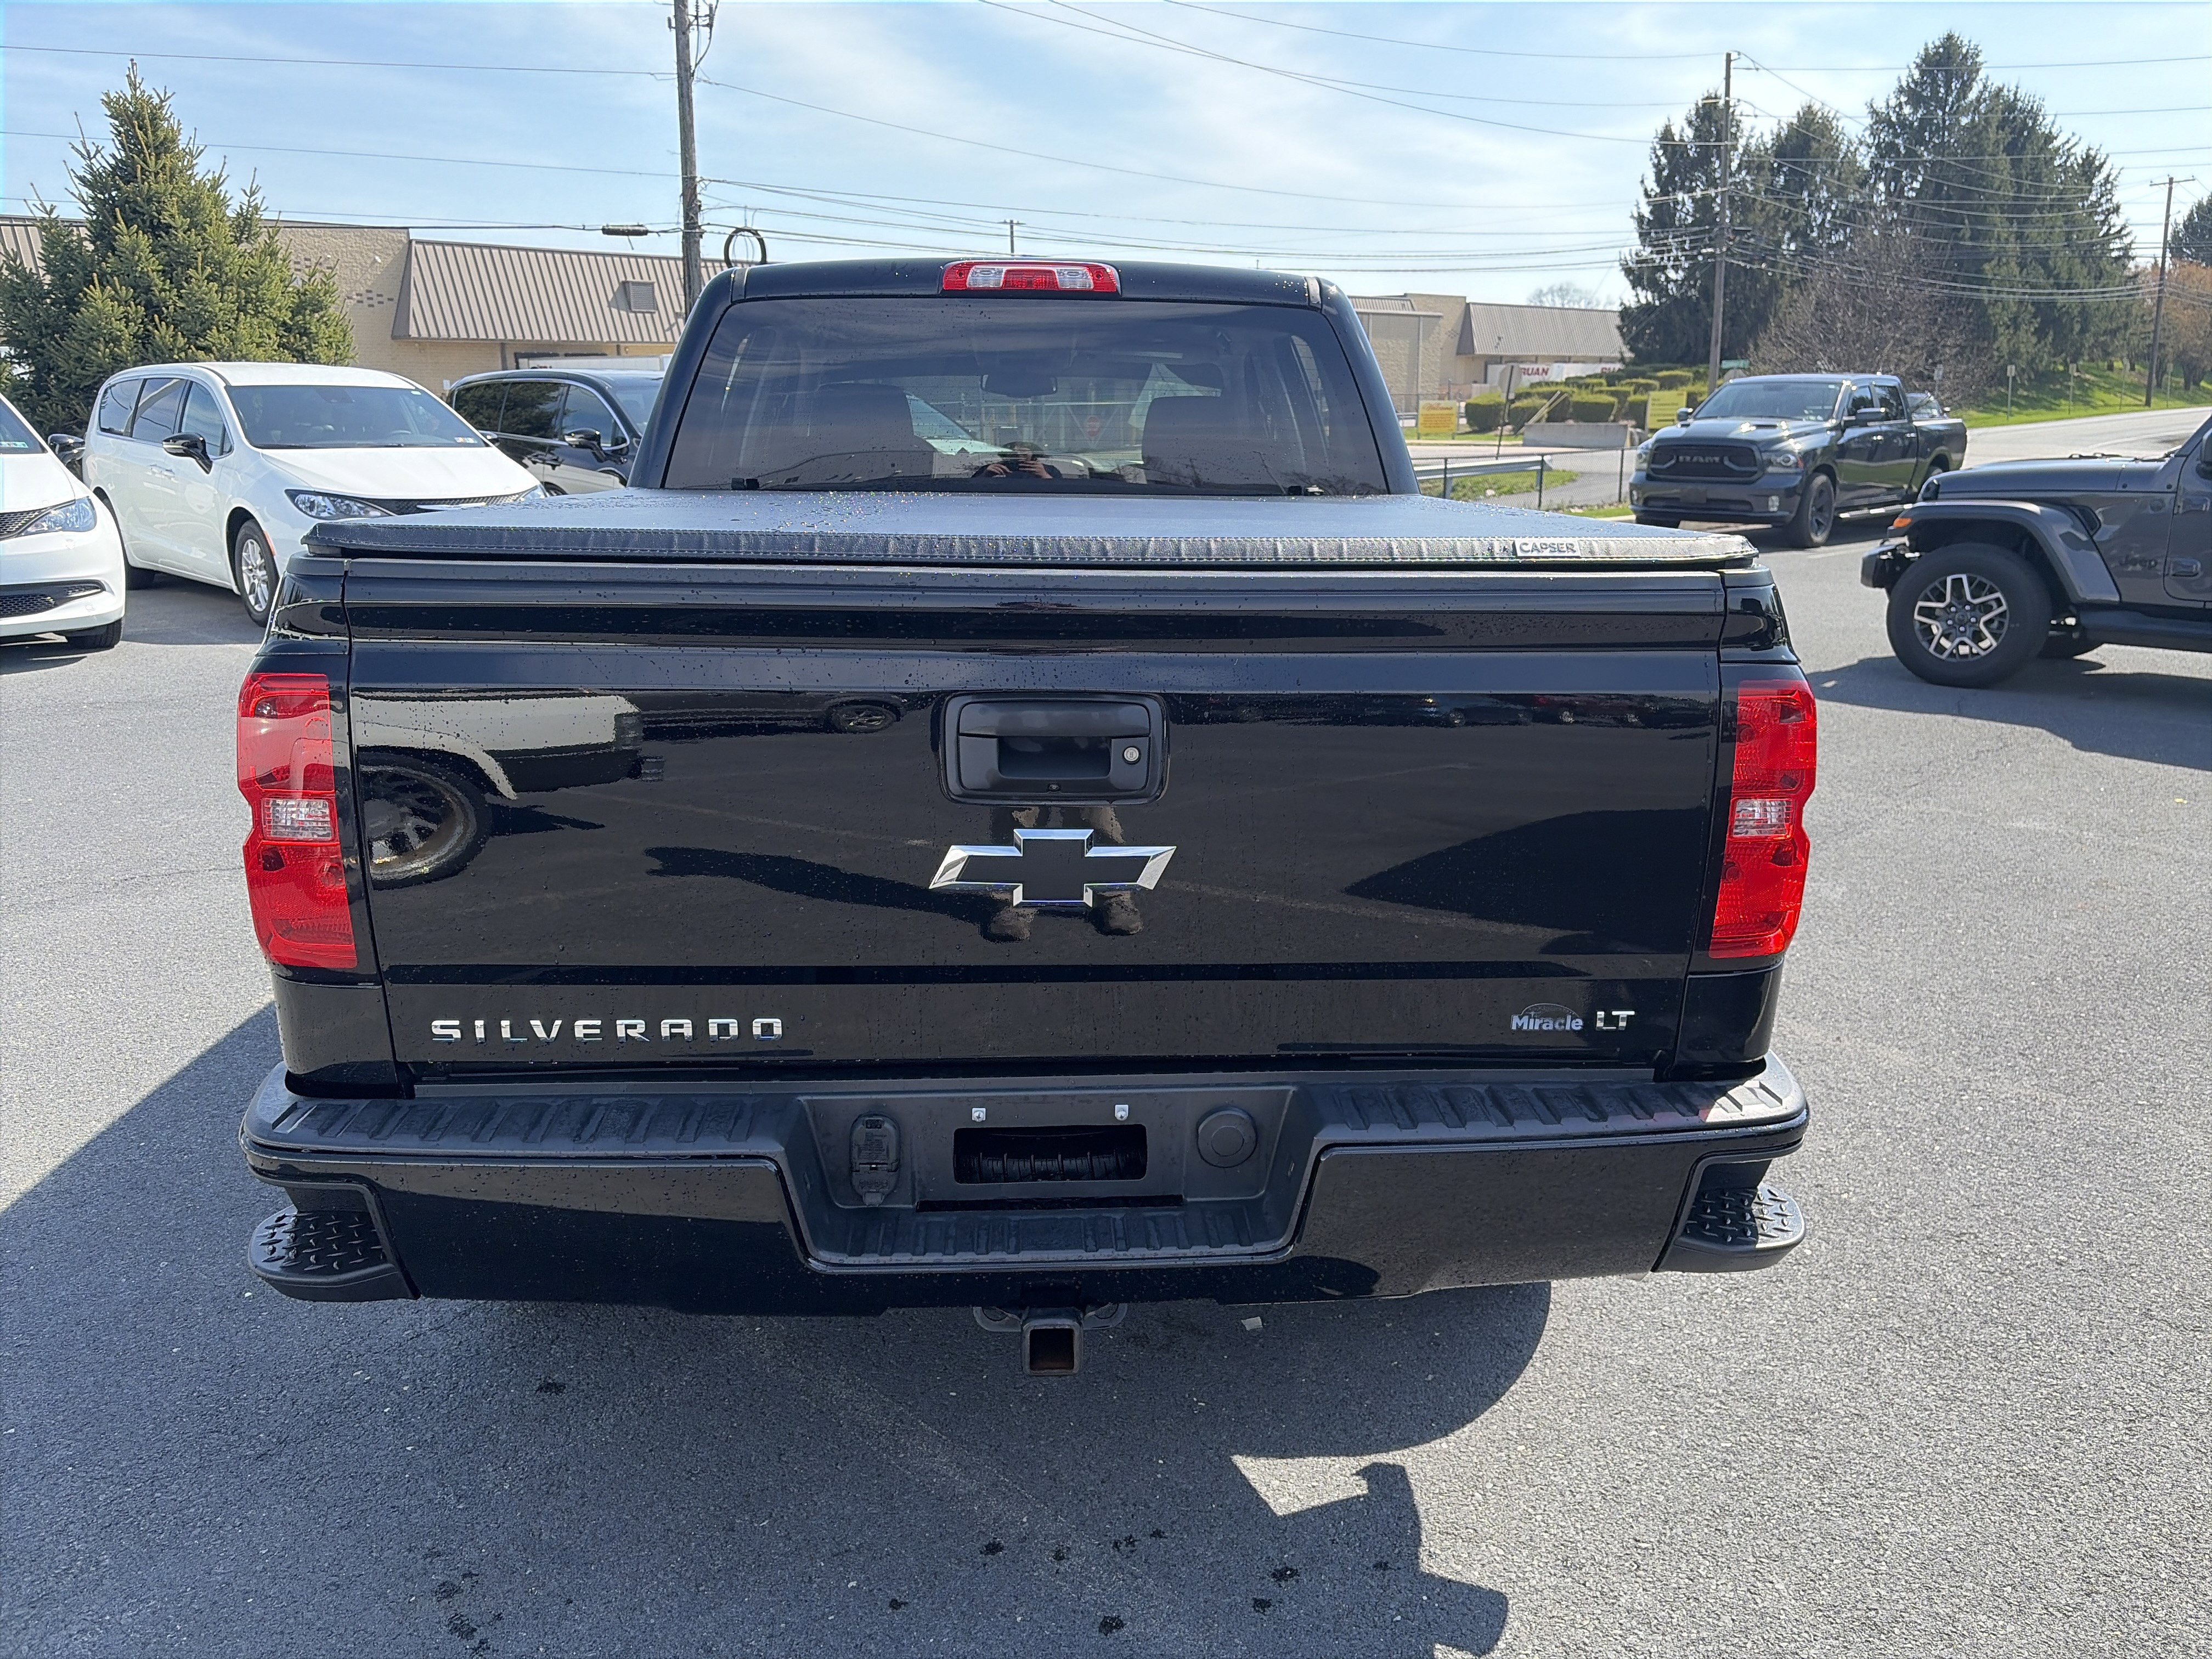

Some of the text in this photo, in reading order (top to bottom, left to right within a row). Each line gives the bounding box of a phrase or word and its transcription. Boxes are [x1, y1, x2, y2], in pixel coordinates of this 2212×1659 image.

[2118, 554, 2158, 570] Jeep
[1511, 1015, 1583, 1030] Miracle
[1596, 1011, 1635, 1030] LT
[431, 1018, 783, 1042] SILVERADO
